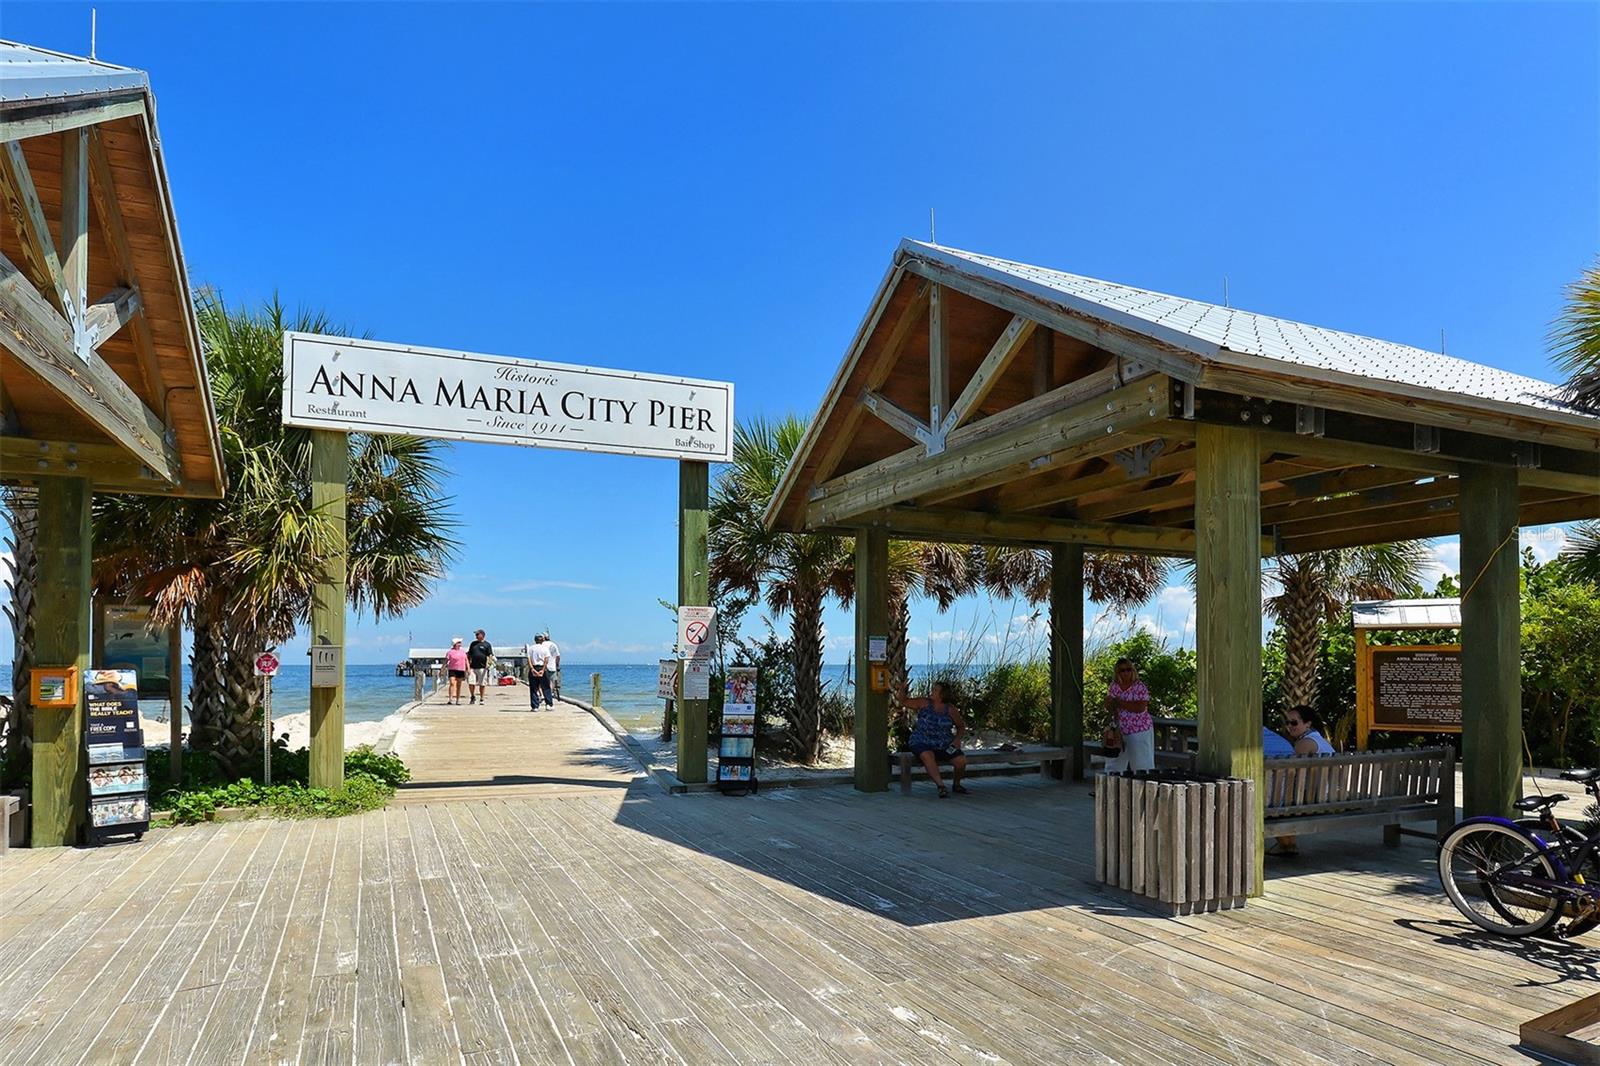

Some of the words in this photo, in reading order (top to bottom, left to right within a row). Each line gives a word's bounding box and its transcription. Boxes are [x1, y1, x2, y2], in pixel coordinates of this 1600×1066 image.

[494, 367, 558, 386] Historic
[306, 364, 424, 405] ANNA
[433, 377, 551, 417] MARIA
[561, 391, 637, 424] CITY
[648, 400, 716, 433] PIER
[307, 404, 367, 418] Restaurant
[486, 415, 525, 430] Since
[532, 422, 566, 434] 1911
[675, 438, 692, 448] Bait
[693, 440, 715, 450] Shop
